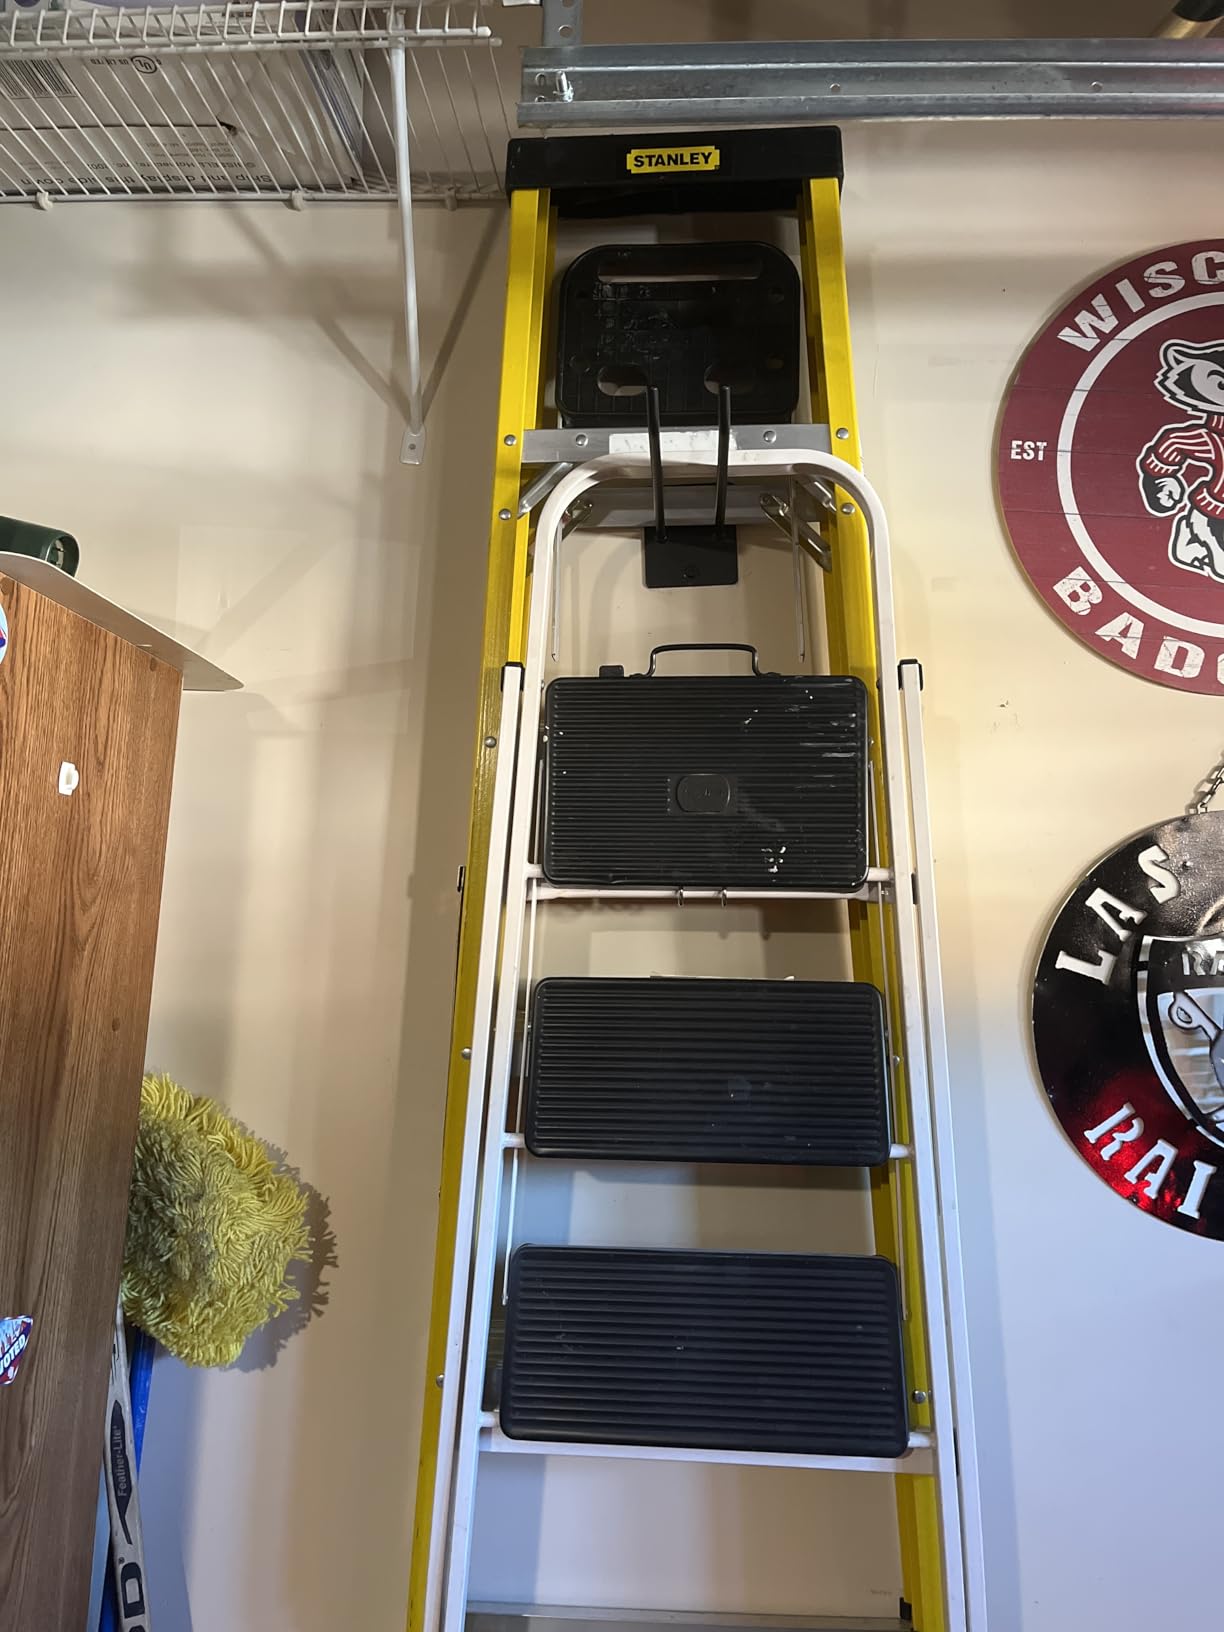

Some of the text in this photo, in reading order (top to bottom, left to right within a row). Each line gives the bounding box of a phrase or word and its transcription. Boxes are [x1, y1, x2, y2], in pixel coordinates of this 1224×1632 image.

[633, 152, 712, 168] STANLEY
[1057, 251, 1224, 352] WISC
[1011, 440, 1048, 461] EST
[1053, 566, 1224, 686] BAD
[1055, 845, 1181, 986] LAS
[1083, 1102, 1217, 1219] RAI
